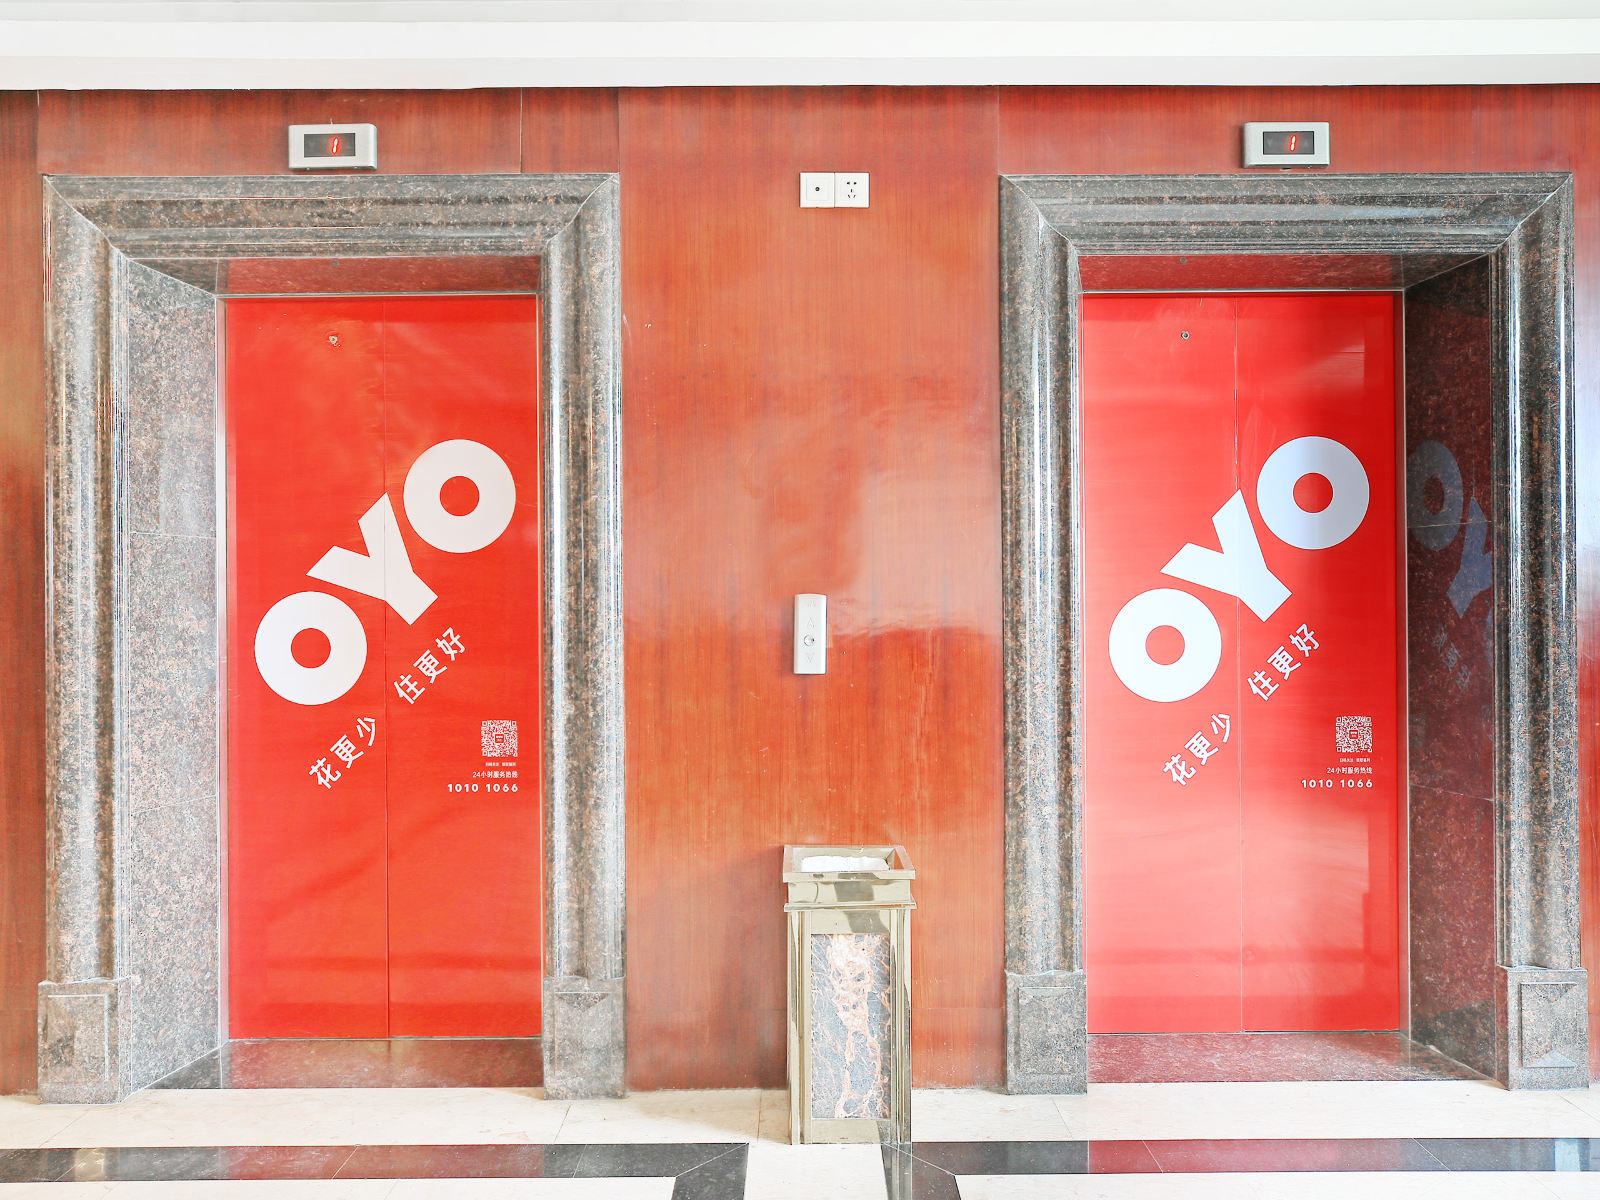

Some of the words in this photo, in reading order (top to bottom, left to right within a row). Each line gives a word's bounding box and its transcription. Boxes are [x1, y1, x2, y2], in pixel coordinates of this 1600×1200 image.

[254, 439, 517, 706] OYO
[1109, 436, 1370, 703] OYO
[309, 717, 376, 790] 花更少
[394, 627, 466, 705] 住更好
[1163, 713, 1232, 786] 花更少
[1248, 623, 1320, 702] 住更好
[1301, 779, 1333, 788] 1010
[1340, 779, 1373, 788] 1066
[447, 783, 479, 793] 1010
[485, 783, 519, 793] 1066
